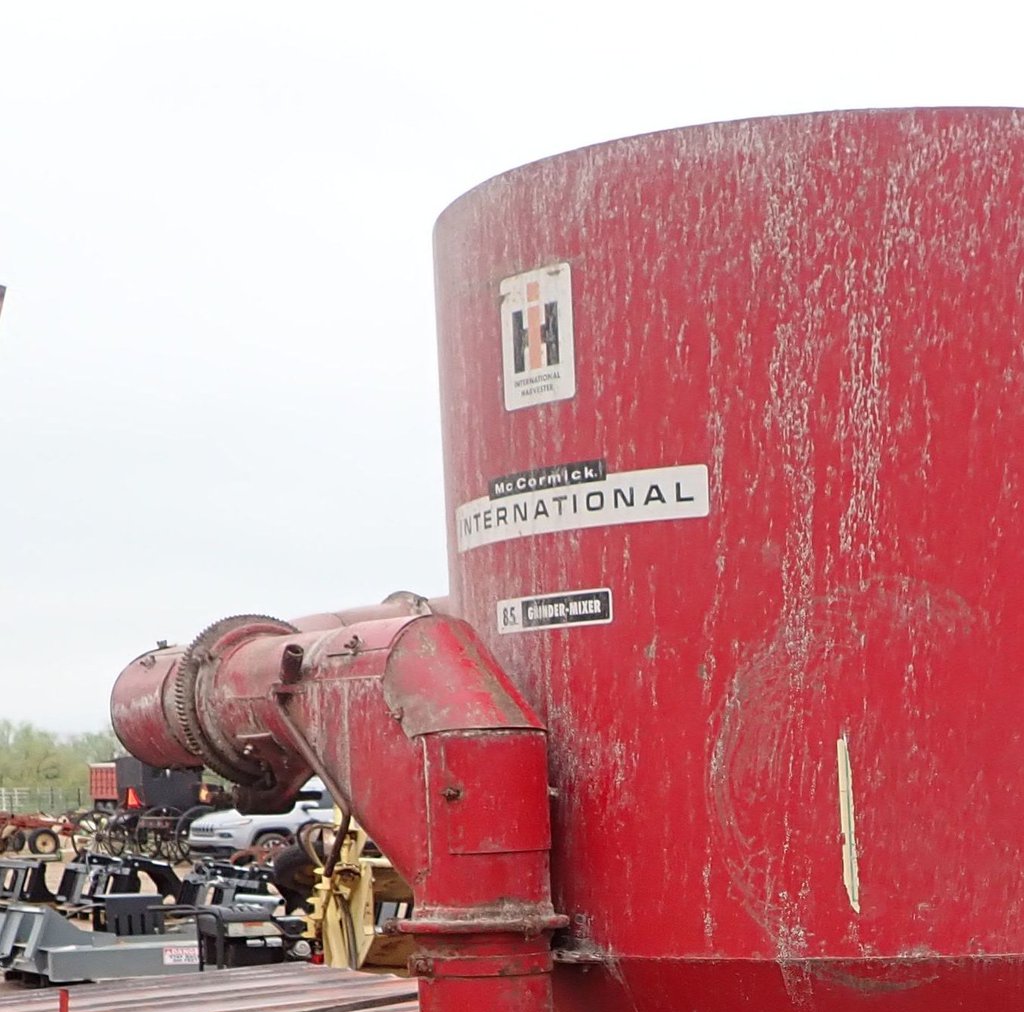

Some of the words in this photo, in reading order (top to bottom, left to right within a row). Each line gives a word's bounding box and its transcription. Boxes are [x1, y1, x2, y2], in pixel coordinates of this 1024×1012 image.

[514, 371, 560, 388] INTERNATIONAL
[521, 384, 553, 396] HARVESTER
[459, 482, 695, 537] INTERNATIONAL
[527, 599, 602, 620] GRINDER-MIXER
